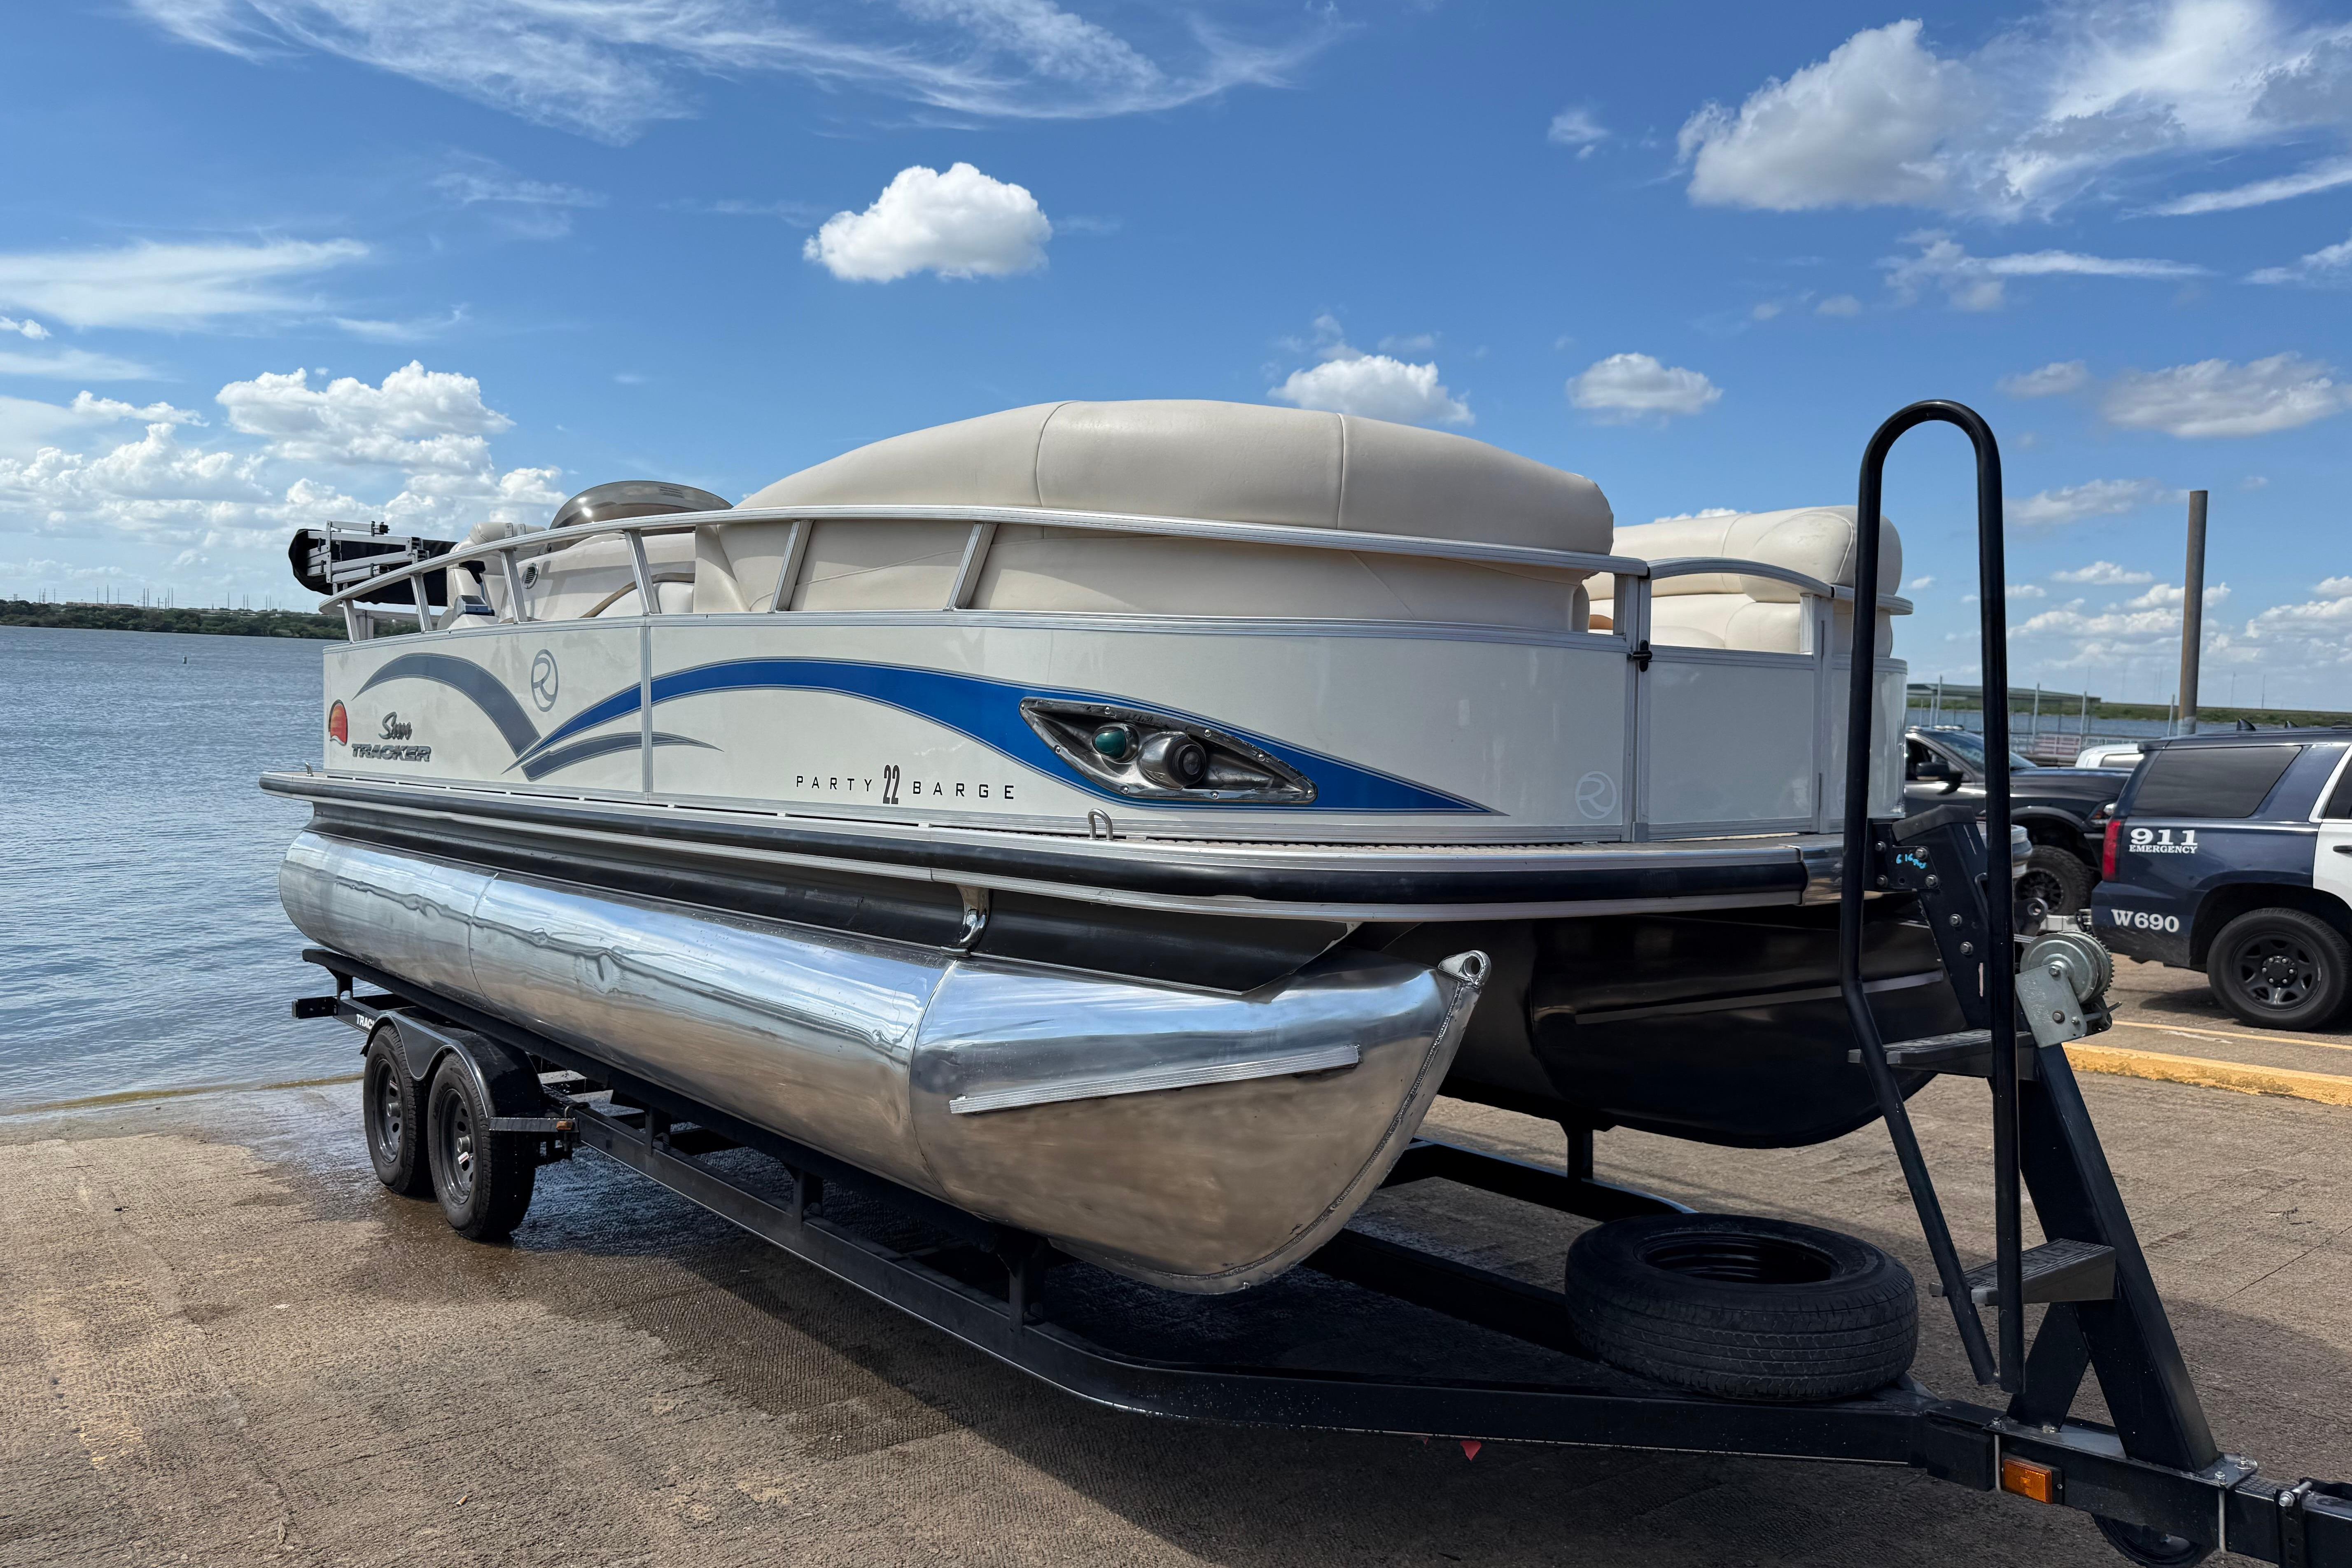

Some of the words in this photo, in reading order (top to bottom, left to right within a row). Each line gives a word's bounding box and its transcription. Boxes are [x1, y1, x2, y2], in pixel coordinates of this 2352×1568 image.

[378, 712, 412, 740] Sun
[352, 743, 431, 762] TRACKER
[796, 775, 872, 792] PARTY
[882, 765, 900, 805] 22
[912, 781, 1014, 800] BARGE
[2130, 828, 2198, 846] 911
[2129, 845, 2198, 854] EMERGENCY
[2111, 909, 2179, 933] W690
